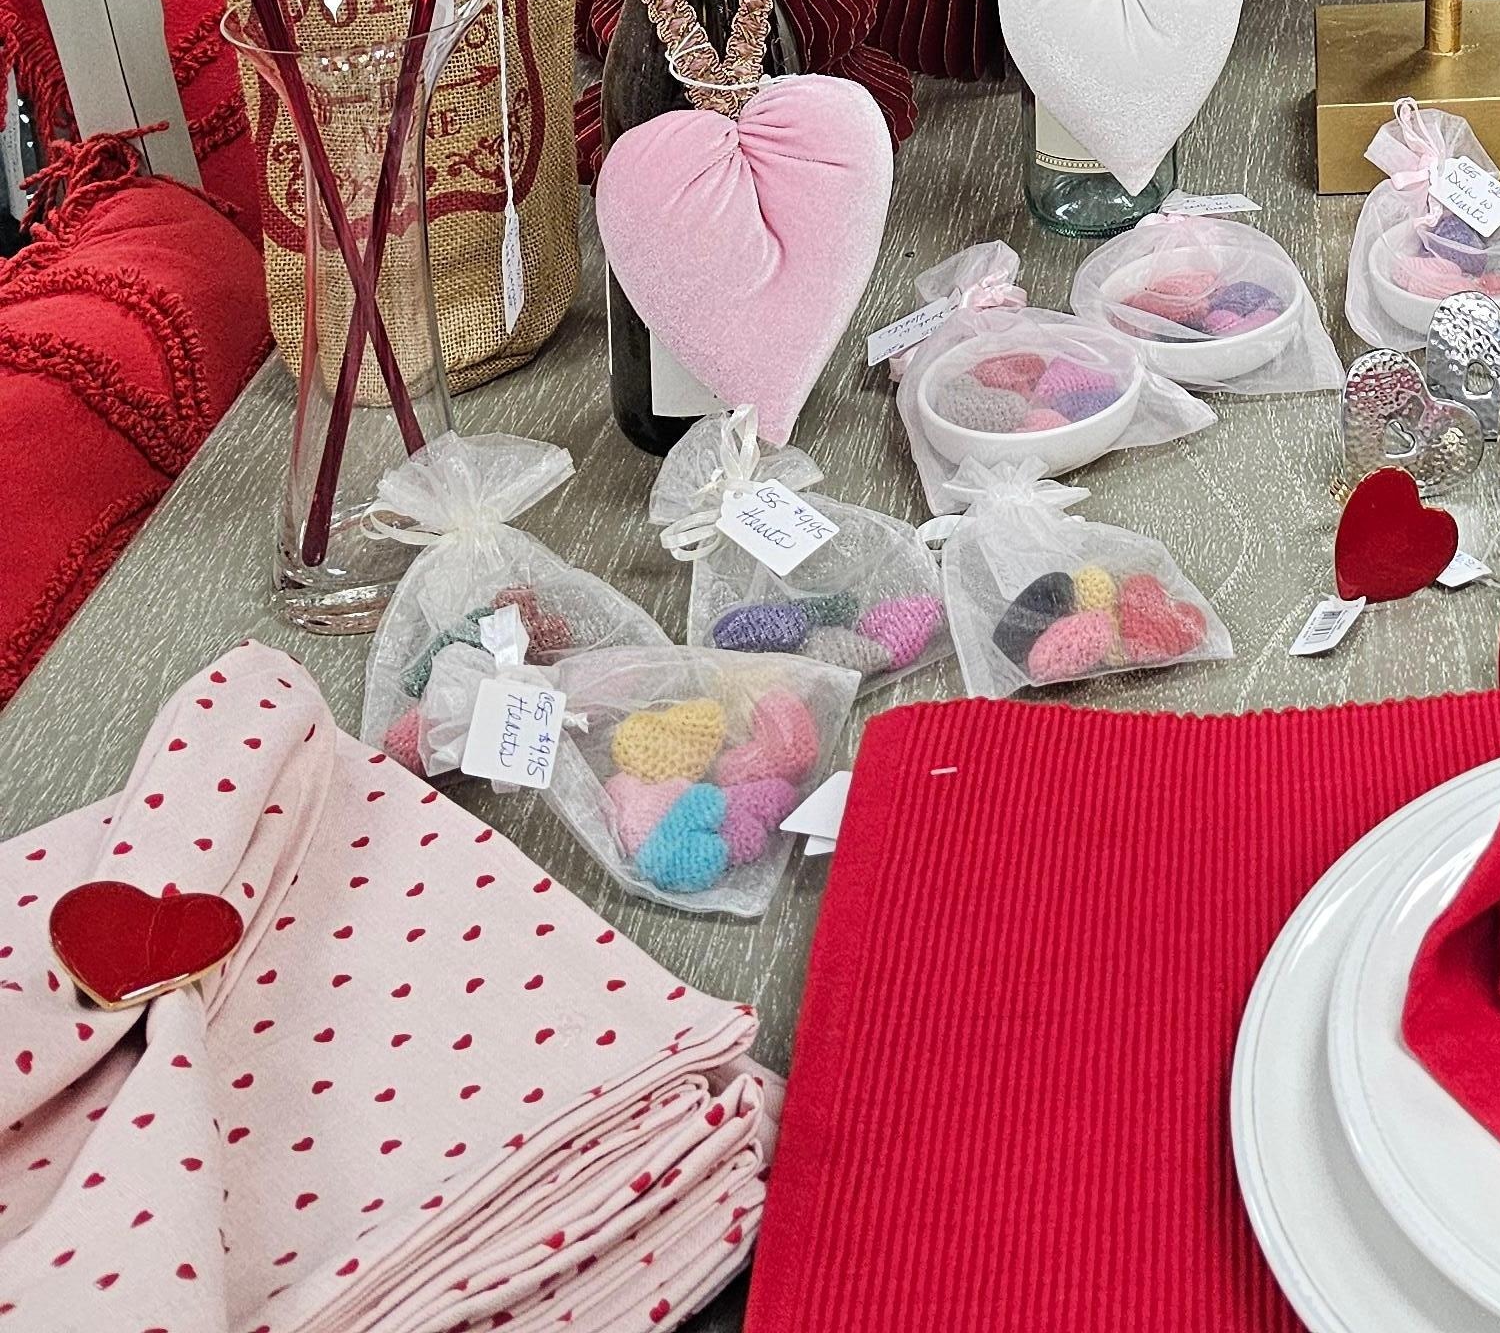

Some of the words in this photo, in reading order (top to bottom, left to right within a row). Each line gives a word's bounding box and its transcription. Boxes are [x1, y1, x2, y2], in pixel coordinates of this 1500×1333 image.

[736, 507, 797, 549] Hearts
[794, 505, 834, 539] $9.95
[498, 694, 532, 767] Hearts
[527, 732, 555, 784] $9.95
